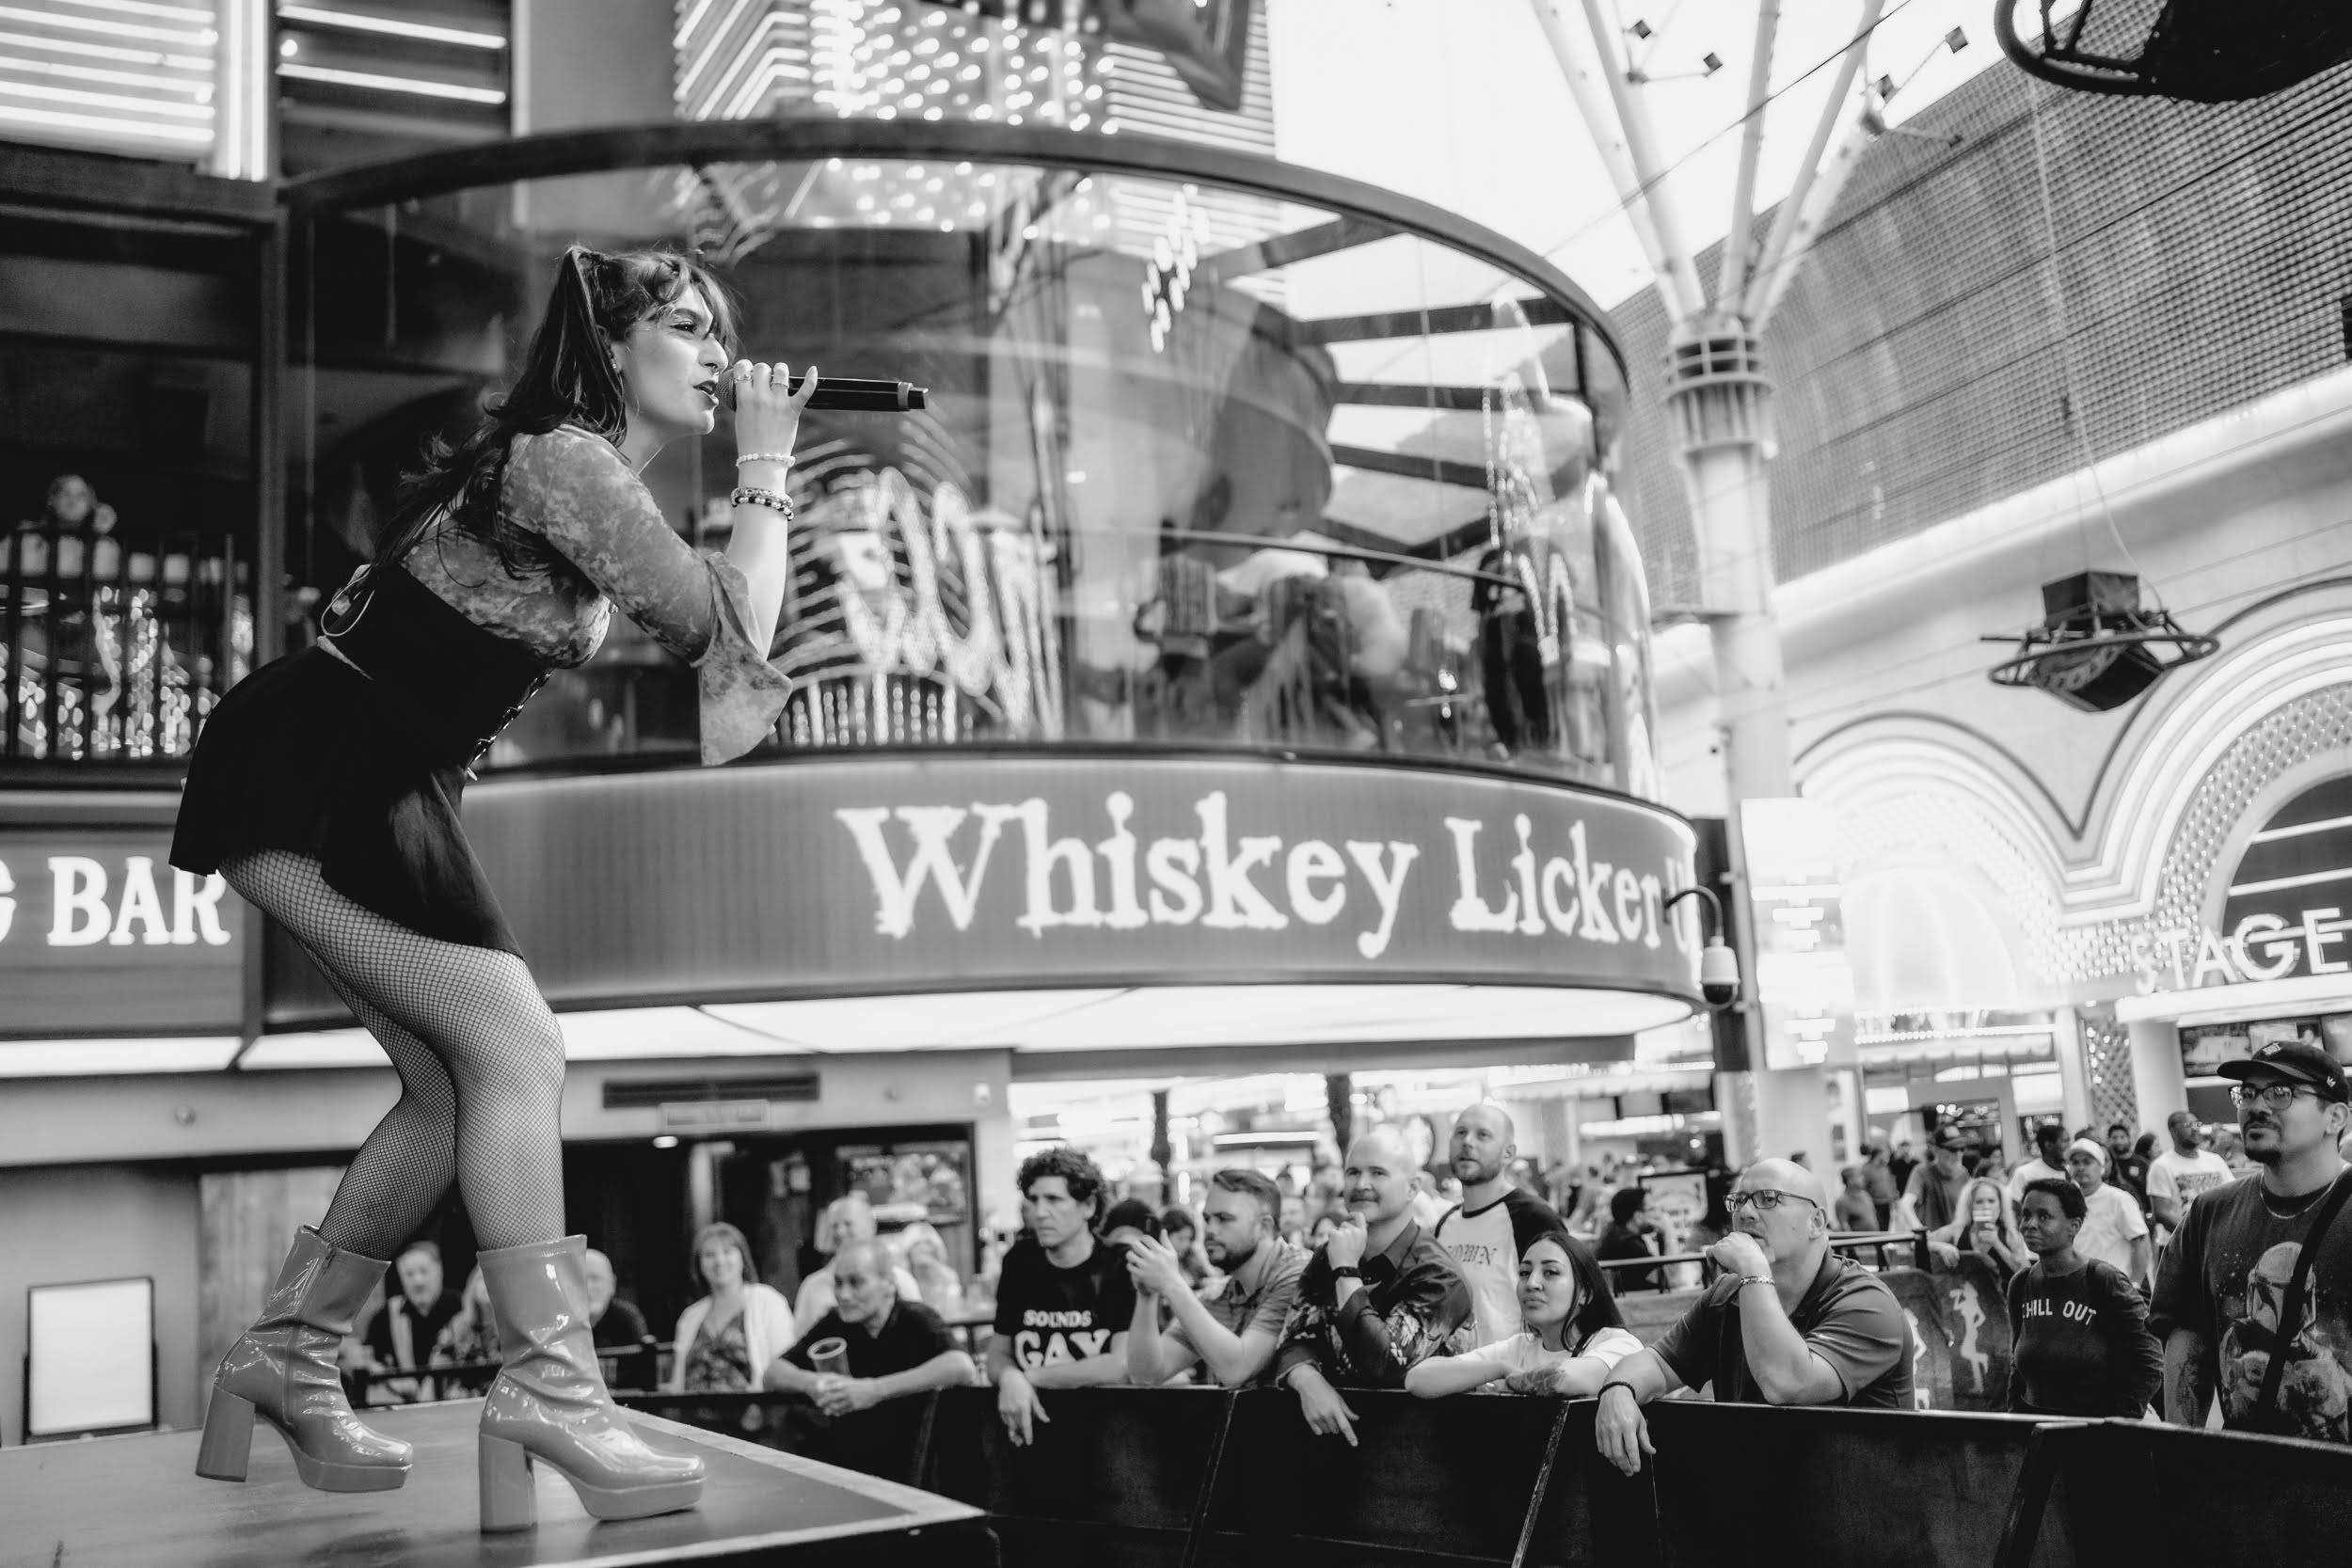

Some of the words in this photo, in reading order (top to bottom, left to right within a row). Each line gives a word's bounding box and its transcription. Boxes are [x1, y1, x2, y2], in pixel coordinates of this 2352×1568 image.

[46, 855, 232, 947] BAR
[834, 790, 1420, 959] Whiskey
[1443, 813, 1662, 950] Licker
[2129, 906, 2349, 996] STAGE
[1023, 1308, 1092, 1328] SOUNDS
[2062, 1299, 2097, 1325] OUT
[1014, 1328, 1111, 1371] GAY
